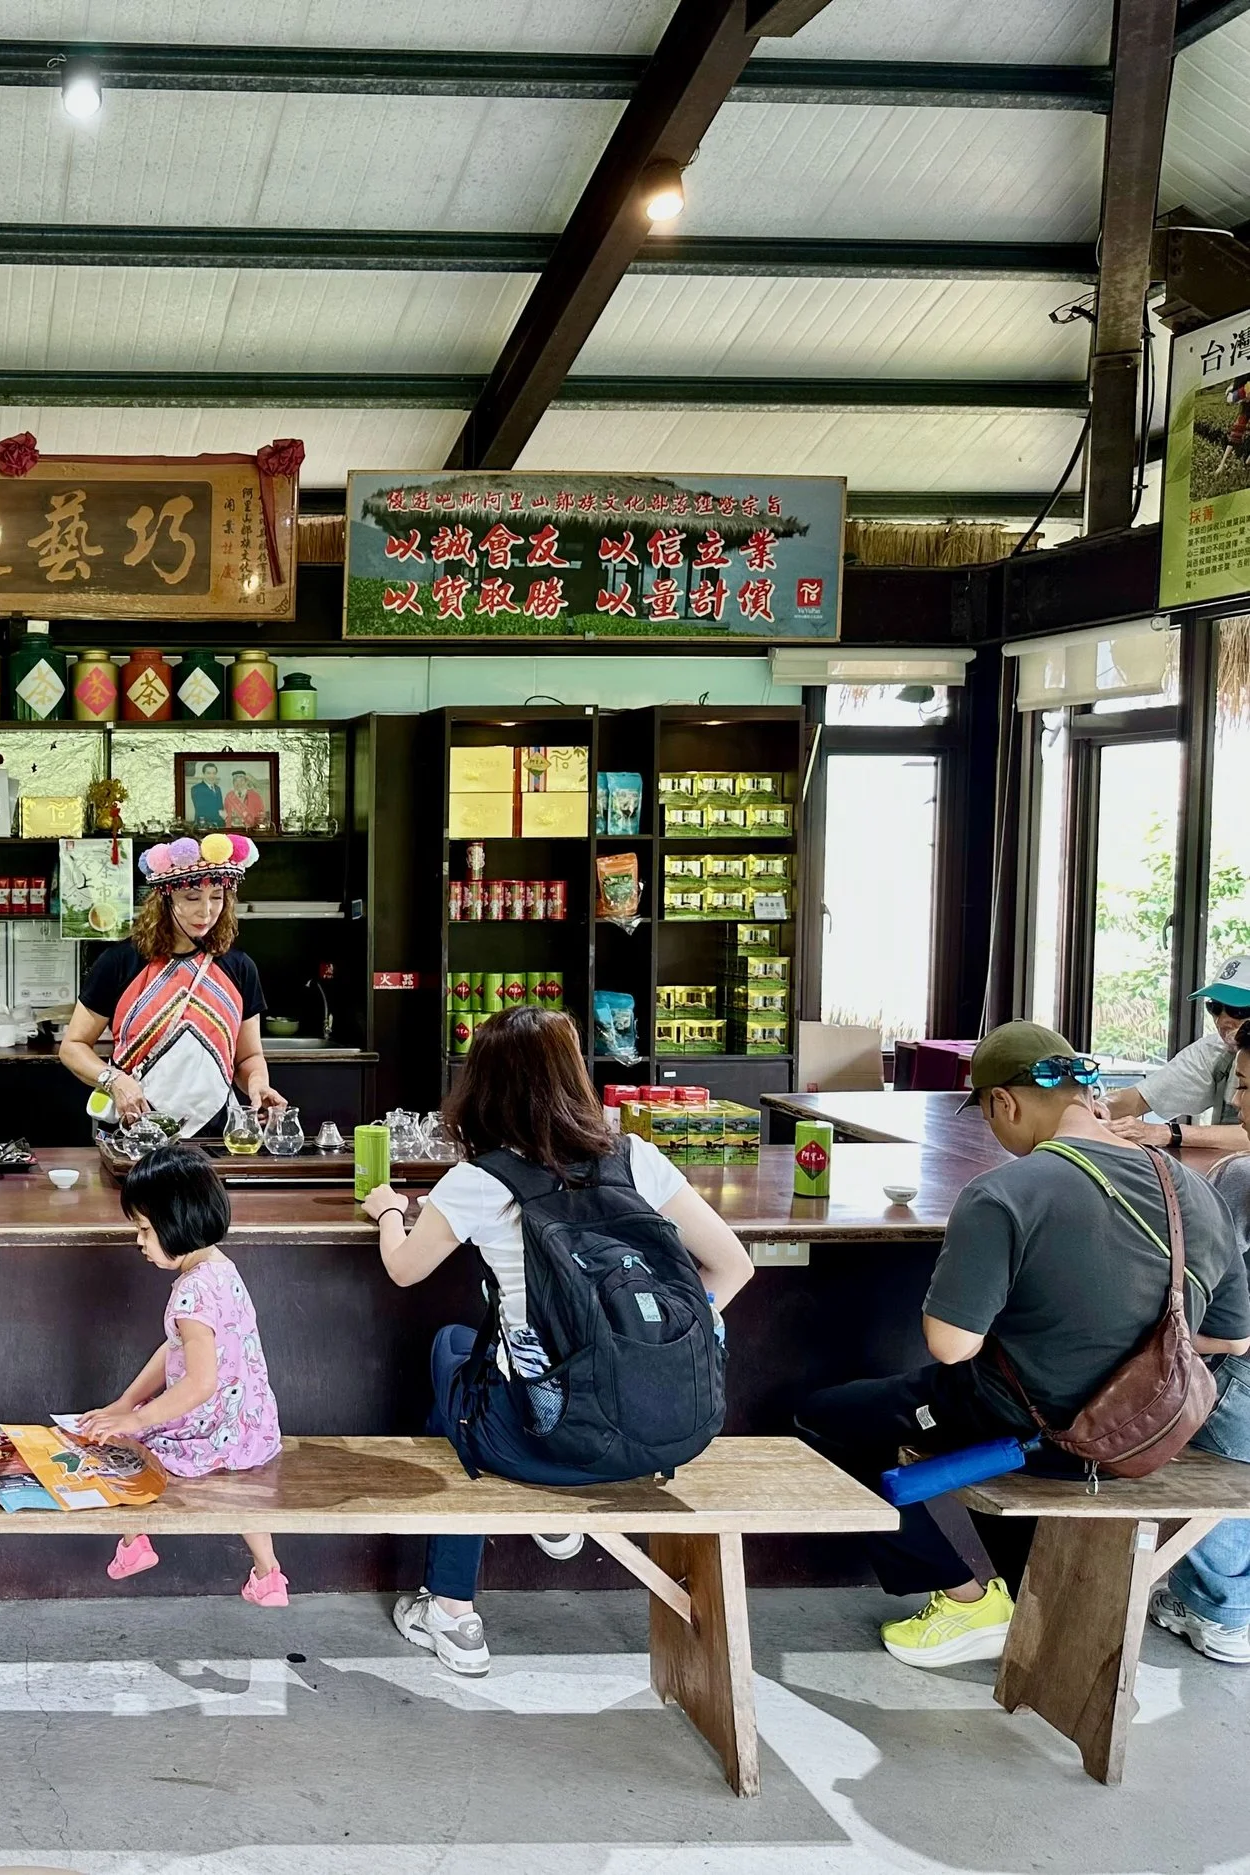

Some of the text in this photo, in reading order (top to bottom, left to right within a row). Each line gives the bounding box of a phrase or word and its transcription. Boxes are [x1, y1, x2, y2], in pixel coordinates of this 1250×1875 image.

[384, 523, 780, 572] 以誠會友 以信立業
[382, 577, 775, 622] 以質取勝 以量計價
[24, 665, 62, 706] 茶
[134, 673, 165, 706] 茶
[801, 1150, 825, 1161] 阿里山
